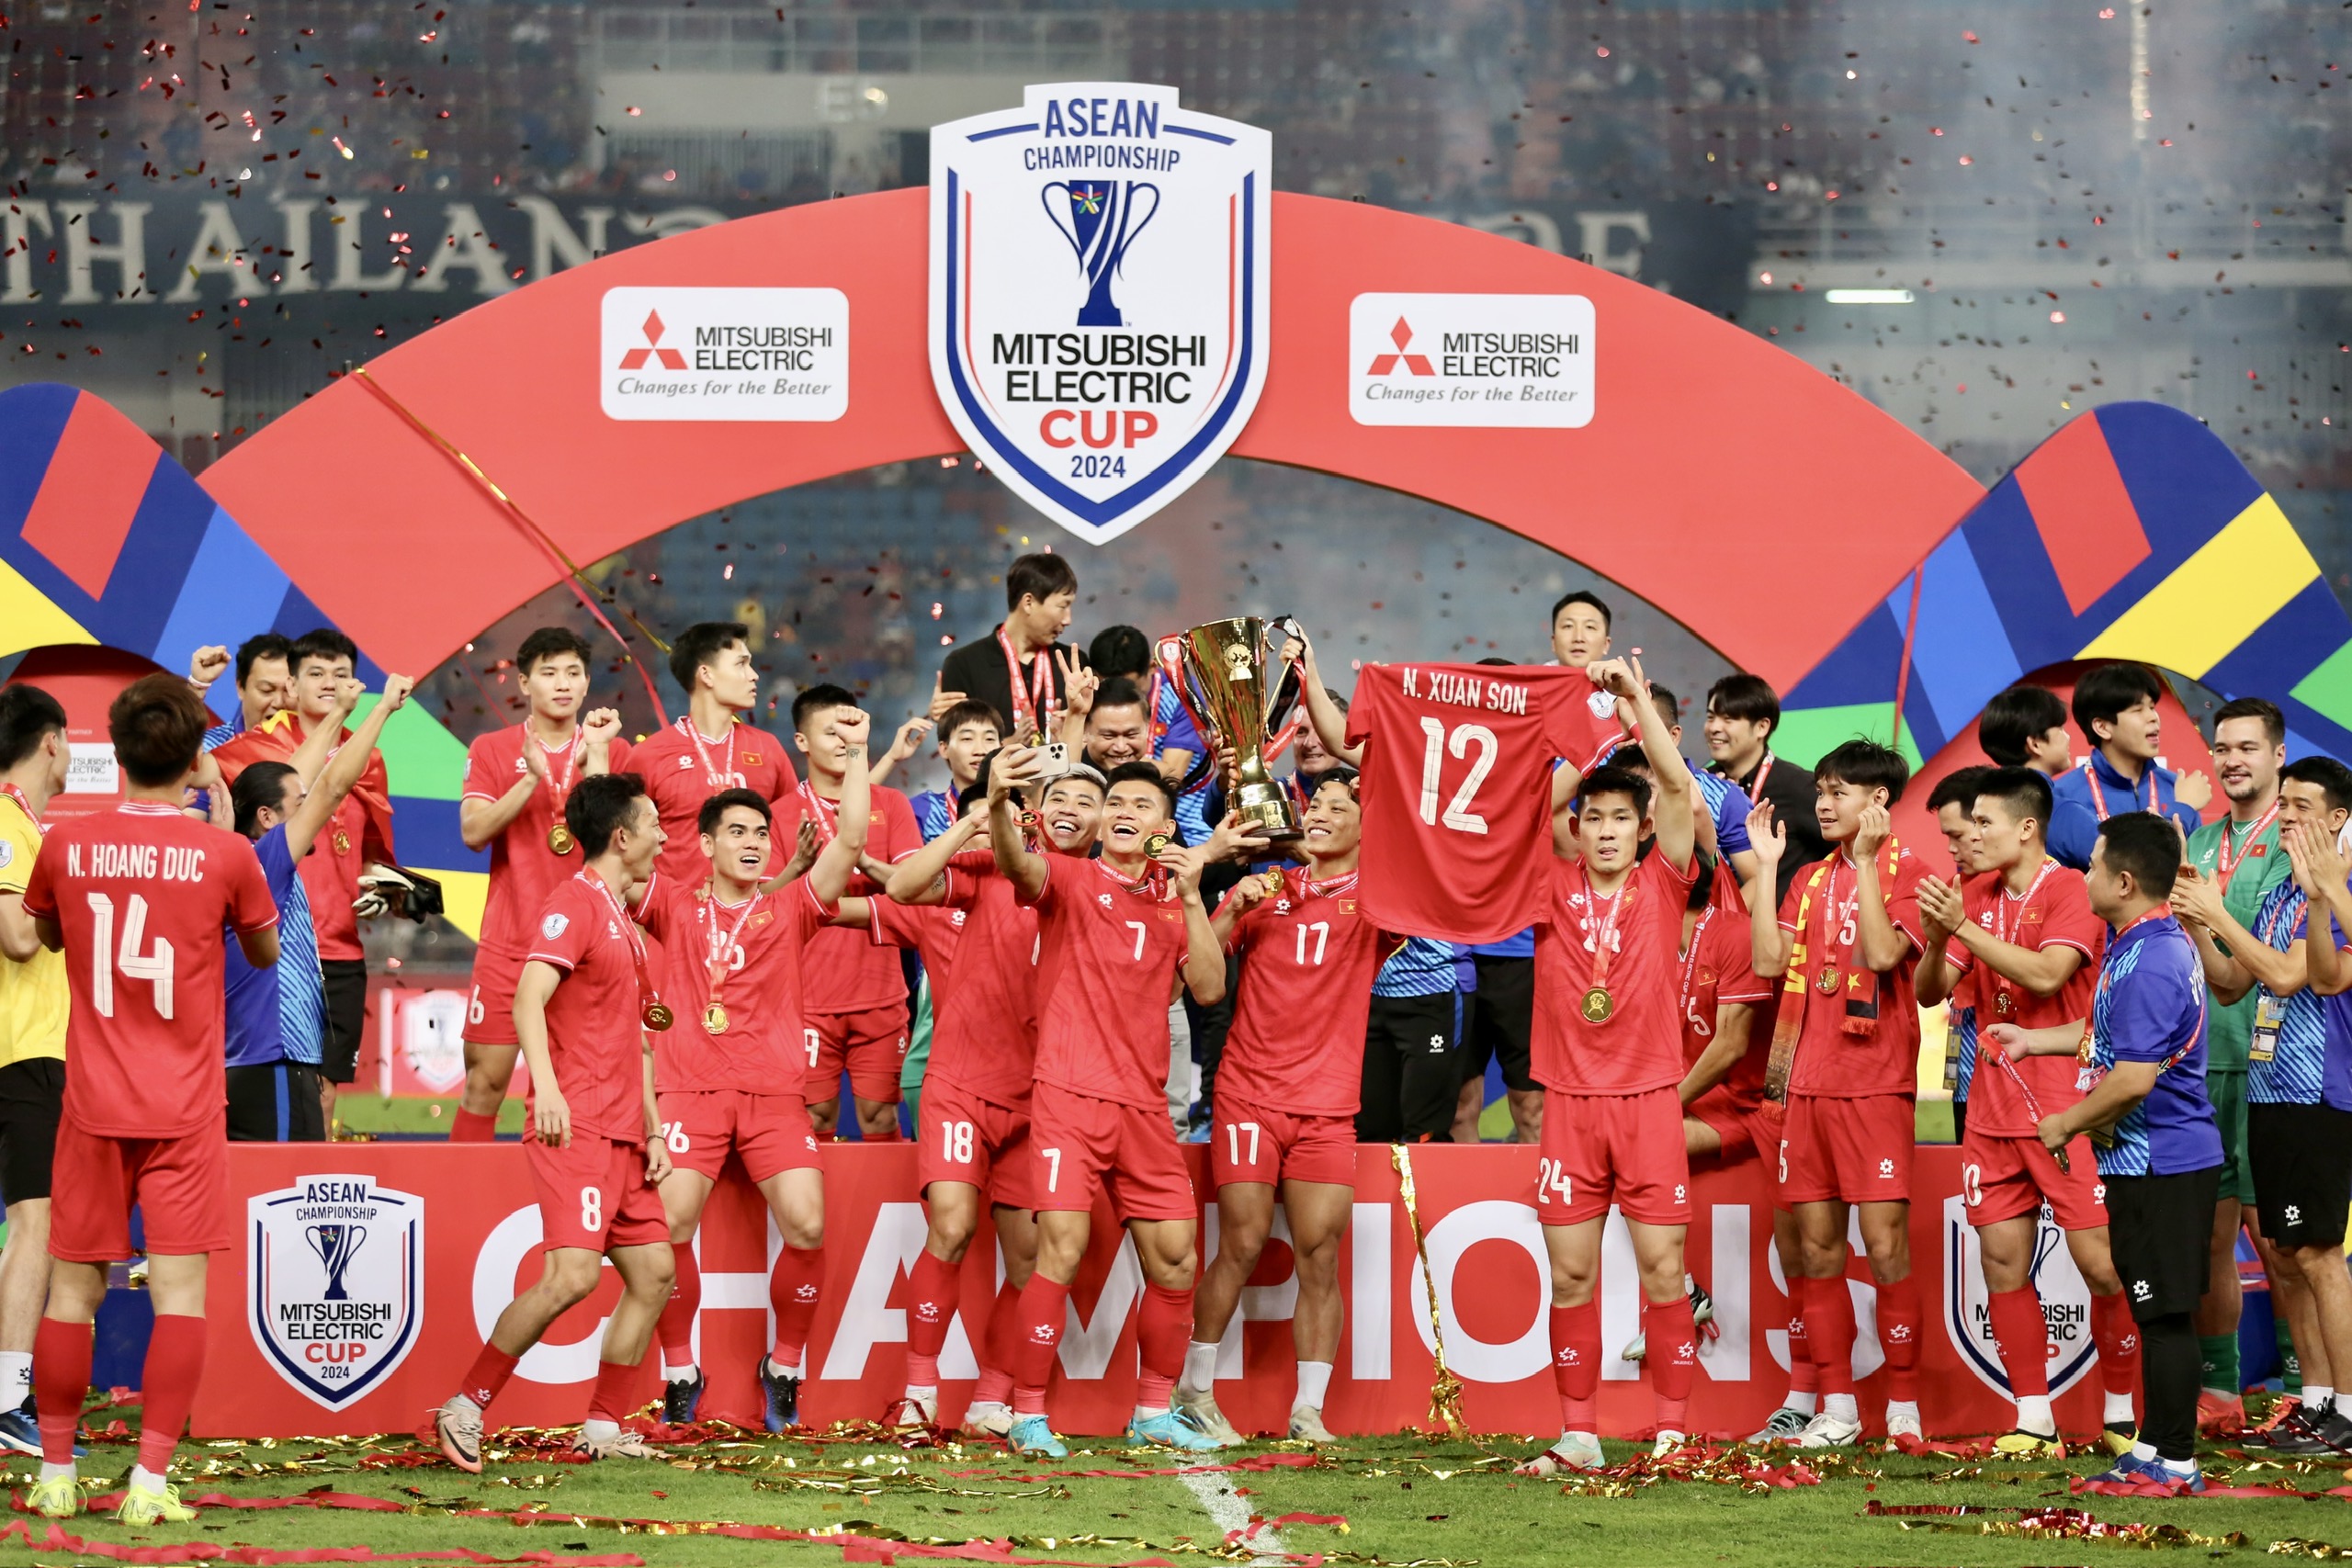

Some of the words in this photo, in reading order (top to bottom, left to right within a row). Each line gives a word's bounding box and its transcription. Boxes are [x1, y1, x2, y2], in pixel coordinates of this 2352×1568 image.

[1045, 98, 1159, 139] ASEAN
[1024, 145, 1181, 172] CHAMPIONSHIP
[0, 197, 735, 306] THAILAN
[695, 327, 832, 347] MITSUBISHI
[992, 333, 1205, 367] MITSUBISHI
[1443, 333, 1578, 355] MITSUBISHI
[695, 350, 813, 371] ELECTRIC
[1443, 356, 1560, 378] ELECTRIC
[617, 378, 697, 397] Changes
[703, 380, 732, 396] for
[738, 380, 766, 394] the
[774, 378, 831, 395] Better
[1006, 370, 1192, 404] ELECTRIC
[1365, 383, 1444, 403] Changes
[1451, 386, 1479, 402] for
[1485, 386, 1514, 400] the
[1520, 385, 1577, 402] Better
[1039, 409, 1159, 448] CUP
[1070, 456, 1126, 479] 2024
[1403, 668, 1422, 699] N.
[1429, 672, 1482, 708] XUAN
[1487, 681, 1528, 716] SON
[72, 757, 113, 766] TSUBISHI
[1419, 716, 1498, 834] 12
[68, 844, 85, 877] N.
[93, 844, 157, 879] HOANG
[164, 847, 206, 883] DUC
[87, 892, 175, 1020] 14
[1125, 920, 1147, 961] 7
[1296, 921, 1330, 964] 17
[1684, 957, 1694, 981] ELECTRIC
[469, 984, 485, 1024] 6
[804, 1029, 820, 1067] 9
[943, 1121, 974, 1164] 18
[1226, 1122, 1260, 1166] 17
[1042, 1148, 1062, 1192] 7
[1538, 1157, 1572, 1205] 24
[1962, 1162, 1983, 1207] 0
[307, 1183, 366, 1203] ASEAN
[581, 1187, 602, 1232] 8
[297, 1206, 377, 1221] CHAMPIONSHIP
[281, 1303, 390, 1321] MITSUBISHI
[1975, 1304, 2085, 1322] MBISHI
[288, 1323, 384, 1339] ELECTRIC
[1983, 1324, 2077, 1340] ERIC
[305, 1342, 367, 1363] CUP
[322, 1366, 350, 1379] 2024
